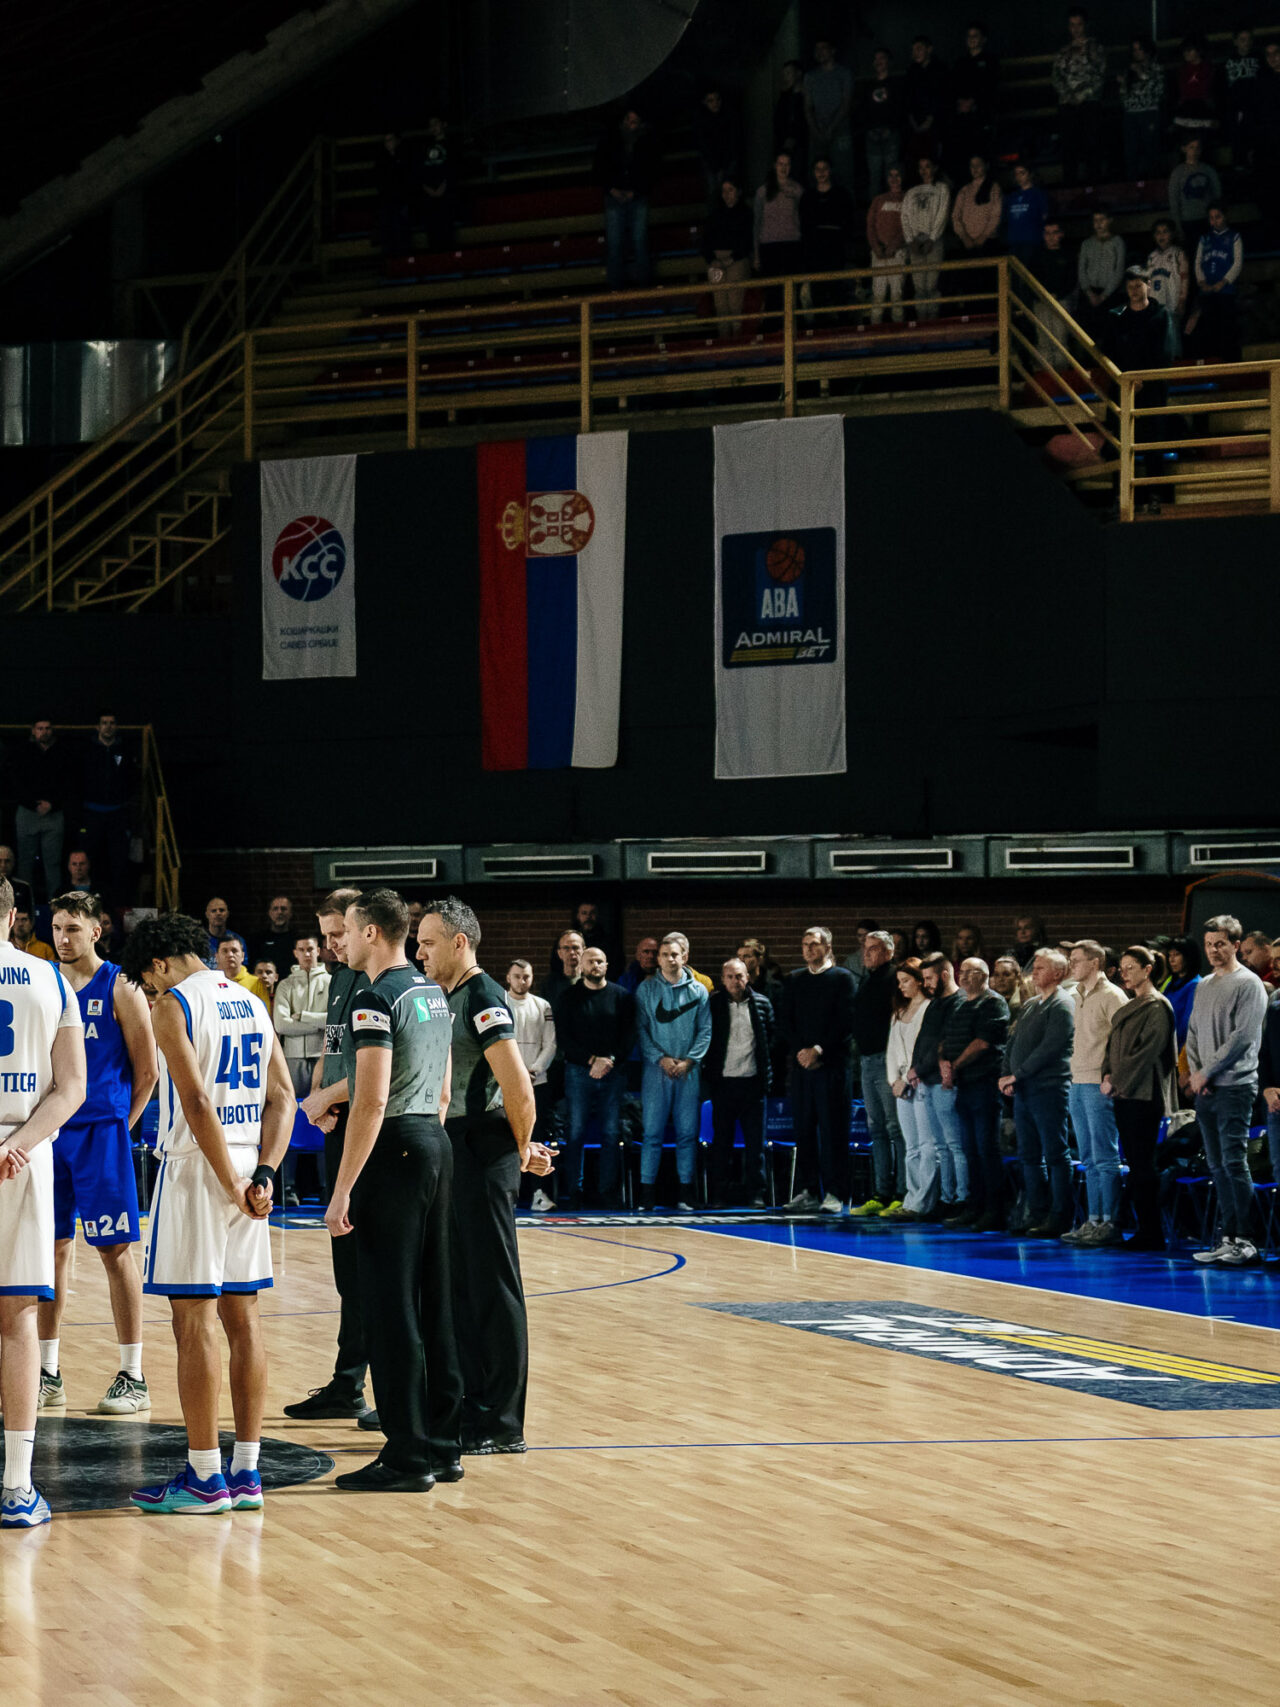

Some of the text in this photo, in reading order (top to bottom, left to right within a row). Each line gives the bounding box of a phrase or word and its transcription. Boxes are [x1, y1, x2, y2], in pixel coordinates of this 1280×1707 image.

[761, 587, 799, 619] ABA
[734, 627, 831, 648] ADMIRAL
[796, 645, 830, 659] BET
[216, 1000, 255, 1020] BOLTON
[214, 1033, 263, 1090] 45
[216, 1103, 261, 1126] UBOTI
[98, 1211, 130, 1237] 24
